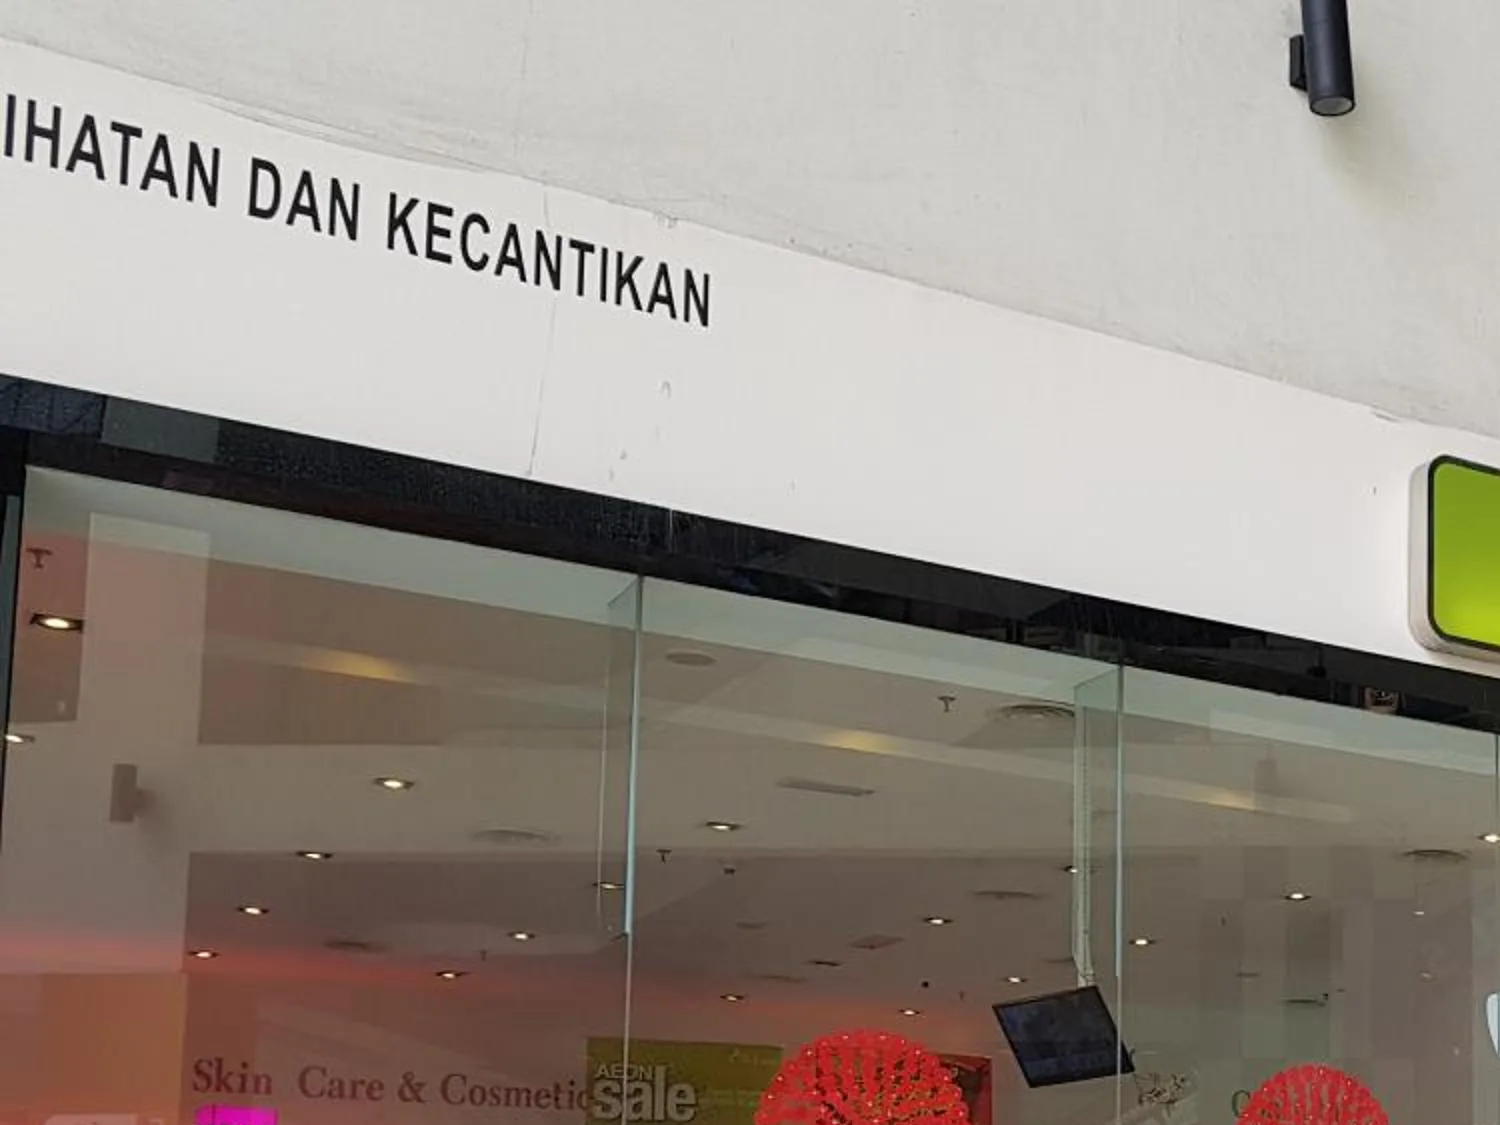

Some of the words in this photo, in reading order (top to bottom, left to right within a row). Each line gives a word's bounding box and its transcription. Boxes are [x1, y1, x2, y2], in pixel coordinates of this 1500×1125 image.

[247, 157, 360, 240] DAN
[387, 192, 711, 327] KECANTIKAN
[193, 1058, 272, 1096] Skin
[298, 1066, 385, 1102] Care
[397, 1072, 427, 1105] &
[593, 1064, 698, 1123] sale
